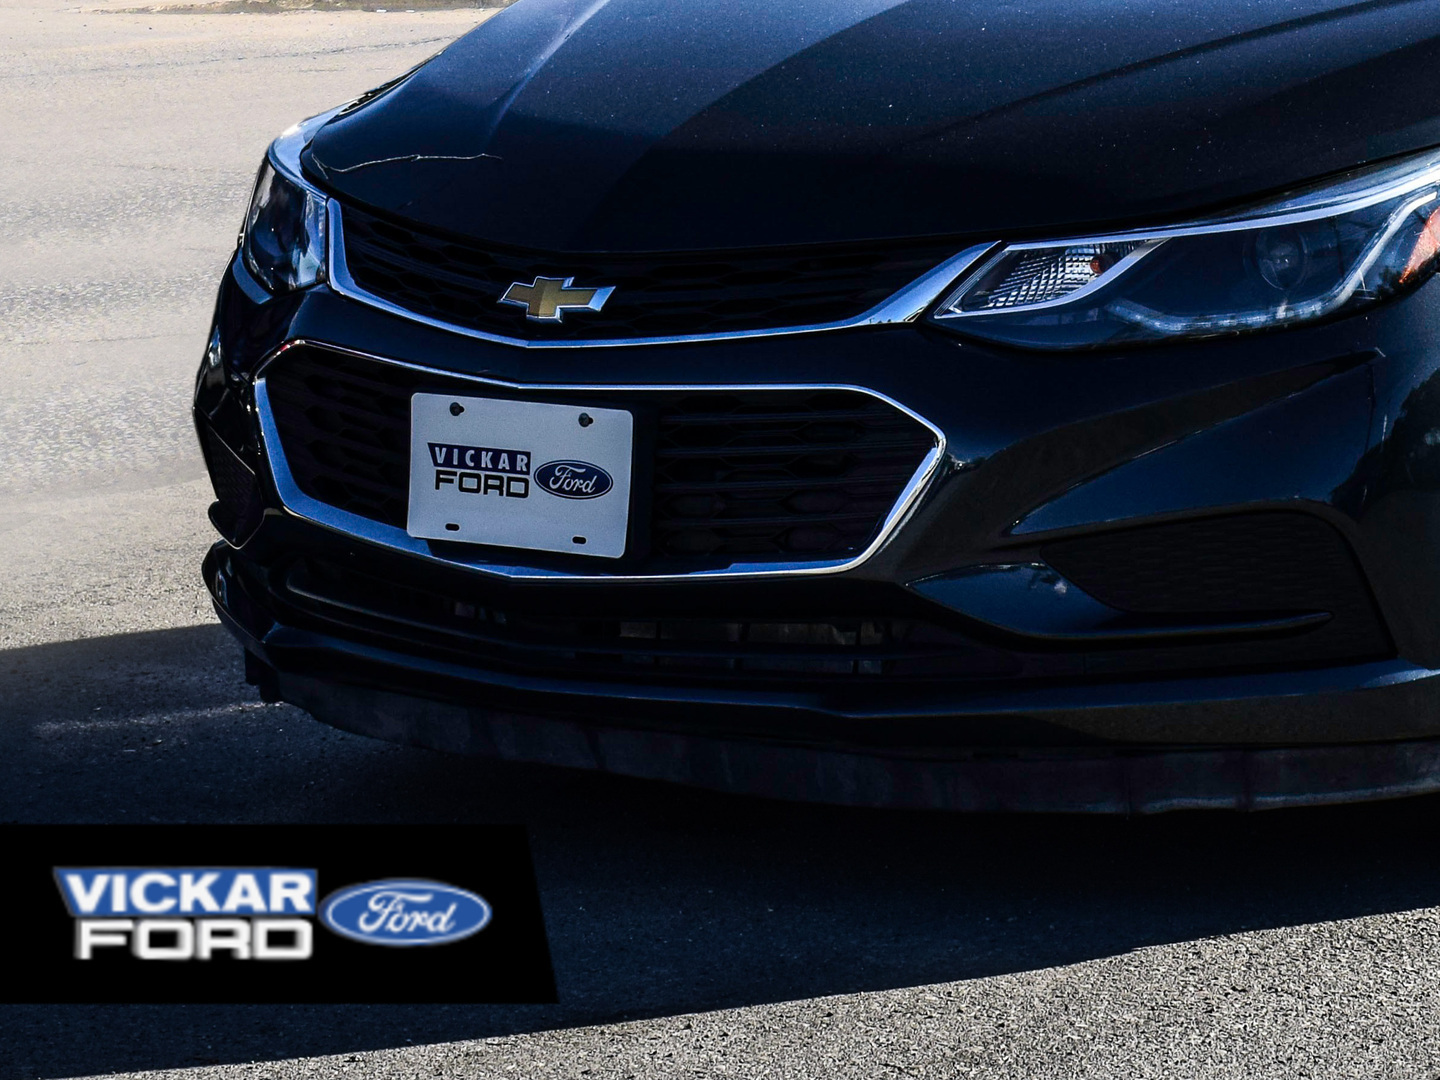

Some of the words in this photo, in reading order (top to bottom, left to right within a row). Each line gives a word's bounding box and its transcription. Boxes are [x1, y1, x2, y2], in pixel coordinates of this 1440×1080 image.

[434, 446, 529, 472] VICKAR
[434, 470, 530, 499] FORD
[549, 464, 598, 495] Ford
